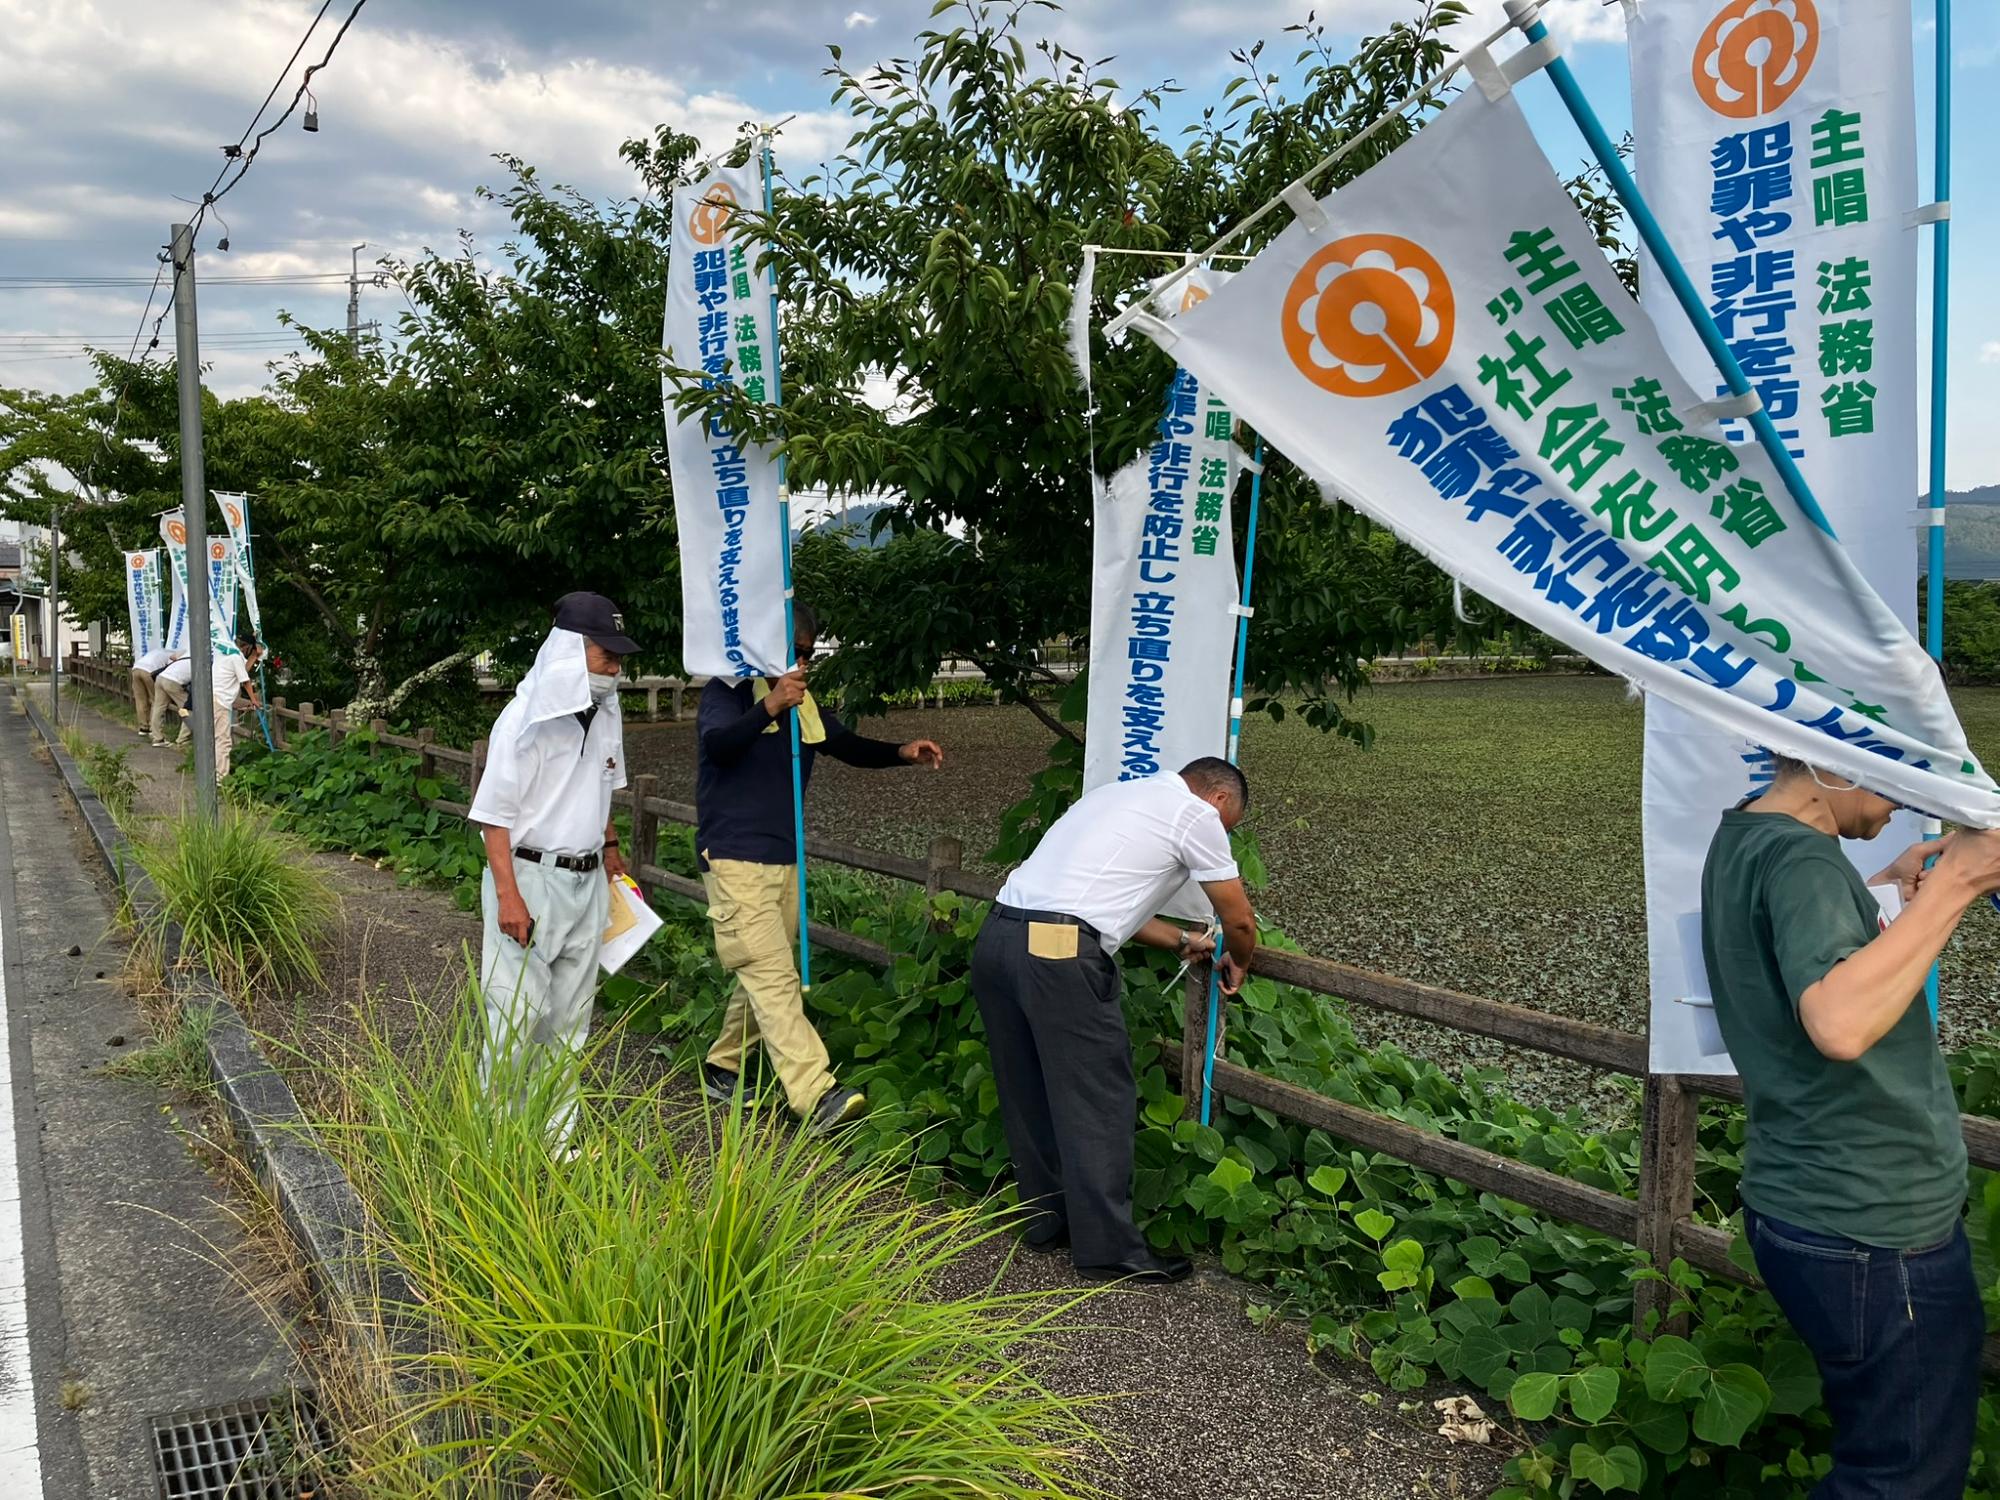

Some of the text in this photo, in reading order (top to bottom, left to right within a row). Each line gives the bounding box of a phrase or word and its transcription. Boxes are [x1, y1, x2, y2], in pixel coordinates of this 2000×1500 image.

[728, 243, 767, 404] 主唱 法務省
[1809, 108, 1878, 438] 主唱 法務省
[1191, 391, 1231, 556] 唱 法務省
[1502, 226, 1788, 549] 主唱 法務省
[1117, 591, 1176, 783] 立ち直りを支える
